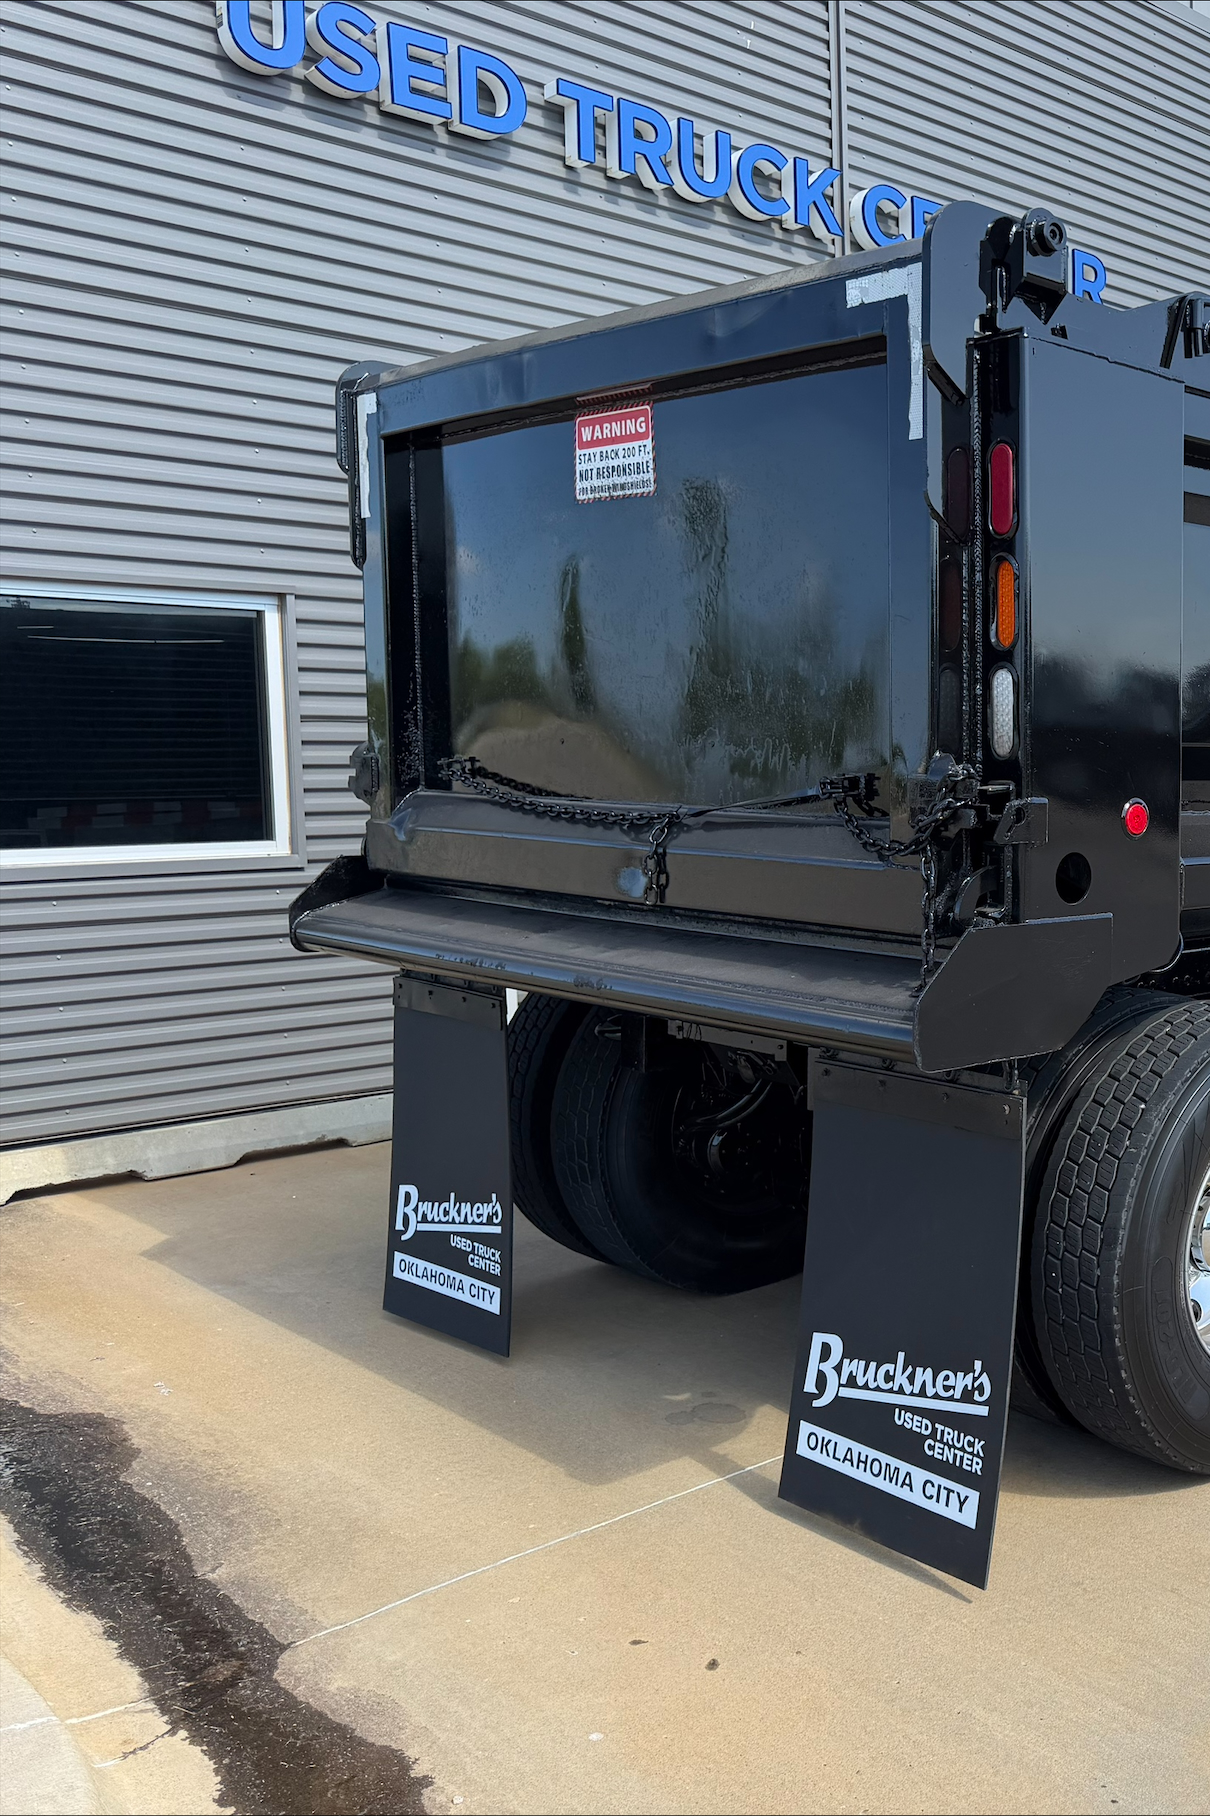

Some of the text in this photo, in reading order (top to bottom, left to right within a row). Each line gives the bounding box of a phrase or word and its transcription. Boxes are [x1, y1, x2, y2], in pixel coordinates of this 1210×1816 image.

[222, 0, 528, 137] USED
[550, 78, 844, 238] TRUCK
[581, 417, 647, 442] WARNING
[578, 444, 650, 465] STAY BACK 200 FT.
[579, 461, 650, 482] NOT RESPONSIBLE
[395, 1184, 502, 1241] Bruckner's
[450, 1233, 501, 1263] USED TRUCK
[468, 1255, 501, 1276] CENTER
[399, 1258, 496, 1305] OKLAHOMA CITY
[803, 1331, 992, 1408] Bruckner's
[894, 1408, 985, 1457] USED TRUCK
[806, 1431, 969, 1514] OKLAHOMA CITY
[924, 1438, 983, 1475] CENTER
